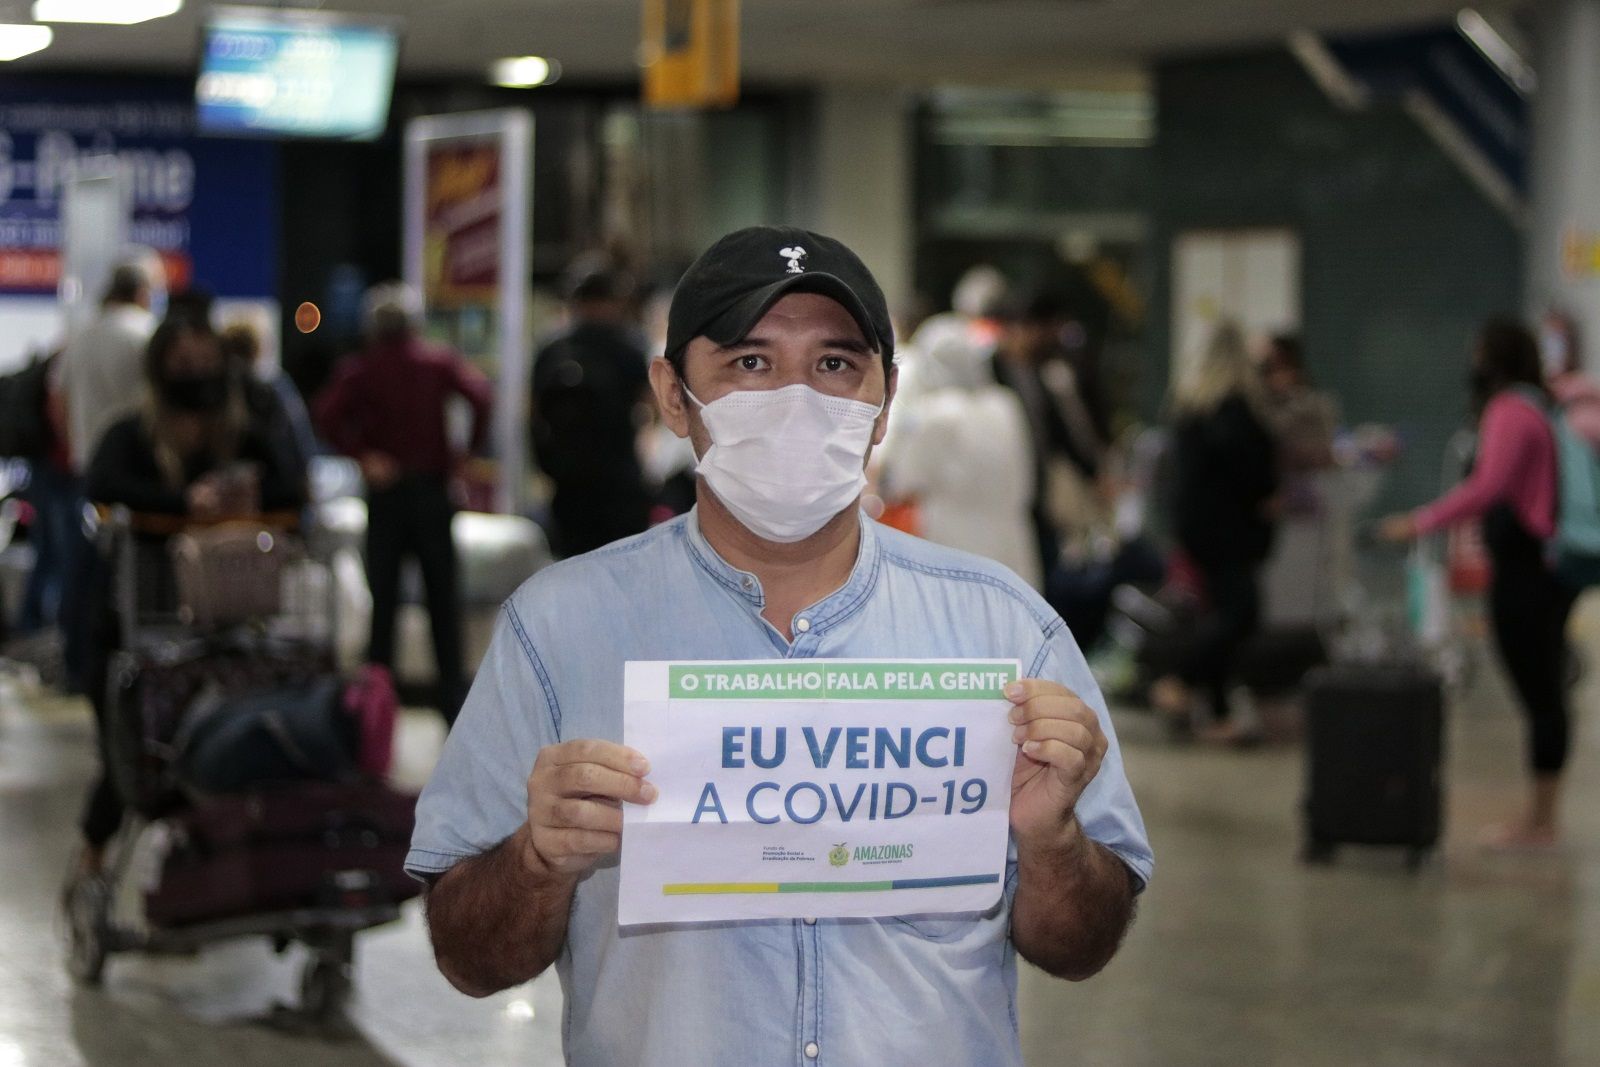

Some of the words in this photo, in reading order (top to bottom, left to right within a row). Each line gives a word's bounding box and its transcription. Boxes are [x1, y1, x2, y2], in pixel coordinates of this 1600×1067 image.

[680, 673, 699, 691] O
[704, 672, 822, 691] TRABALHO
[827, 672, 876, 690] FALA
[884, 672, 935, 690] PELA
[940, 672, 1009, 690] GENTE
[721, 726, 787, 769] EU
[801, 726, 967, 769] VENCI
[691, 782, 729, 825] A
[745, 777, 988, 825] COVID-19
[853, 843, 914, 861] AMAZONAS
